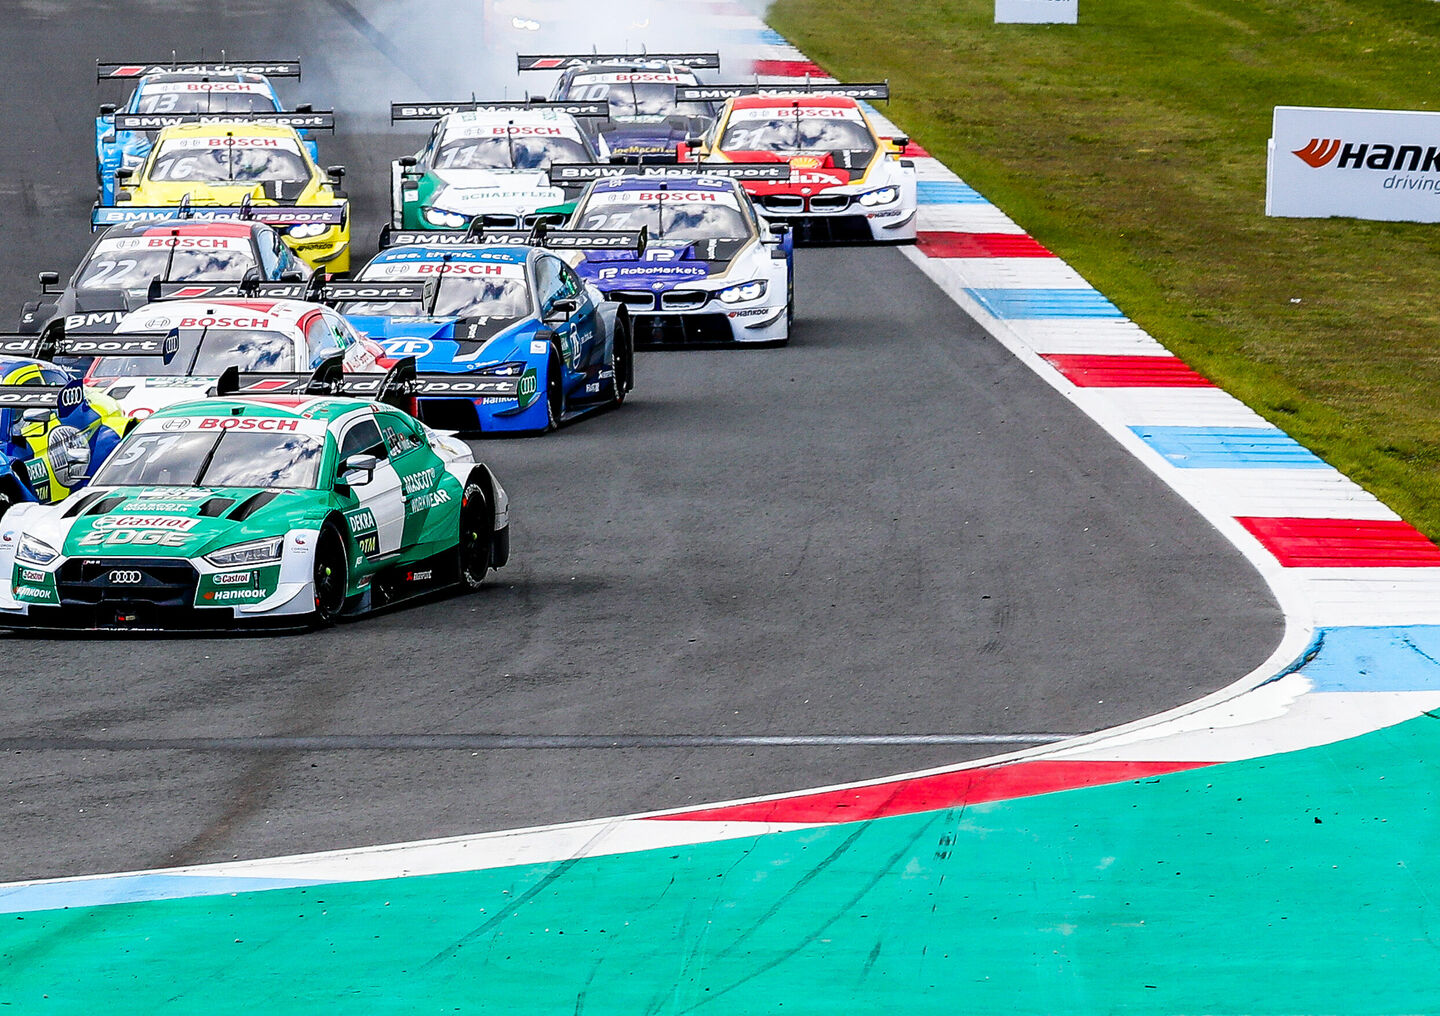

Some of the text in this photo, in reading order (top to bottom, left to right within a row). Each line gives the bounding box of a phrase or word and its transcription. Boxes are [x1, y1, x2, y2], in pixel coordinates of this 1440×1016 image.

[616, 74, 679, 82] BOSCH
[684, 88, 878, 99] BMW Motorsport
[401, 107, 459, 116] BMW
[777, 109, 845, 118] BOSCH
[124, 116, 324, 127] BMW Motorsport
[492, 127, 562, 135] BOSCH
[208, 138, 278, 147] BOSCH
[157, 156, 198, 180] 16
[561, 167, 780, 177] BMW Motorsport
[462, 190, 557, 201] SCHAEFFLER
[639, 192, 716, 202] BOSCH
[106, 211, 173, 222] BMW
[148, 238, 228, 249] BOSCH
[395, 233, 467, 245] BMW
[425, 250, 477, 259] think.
[480, 252, 515, 262] act.
[86, 259, 138, 285] 22
[417, 264, 502, 275] BOSCH
[620, 266, 706, 276] RoboMarkets
[325, 286, 415, 298] Sport
[179, 317, 269, 328] BOSCH
[385, 343, 424, 356] ZF
[198, 418, 299, 432] BOSCH
[112, 435, 182, 466] 51
[402, 470, 434, 494] MASCOT
[410, 489, 452, 514] WORKWEAR
[115, 517, 193, 529] Castrol
[348, 512, 374, 533] DEKRA
[78, 529, 193, 547] EDGE
[25, 571, 45, 582] Castrol
[221, 572, 249, 584] Castrol
